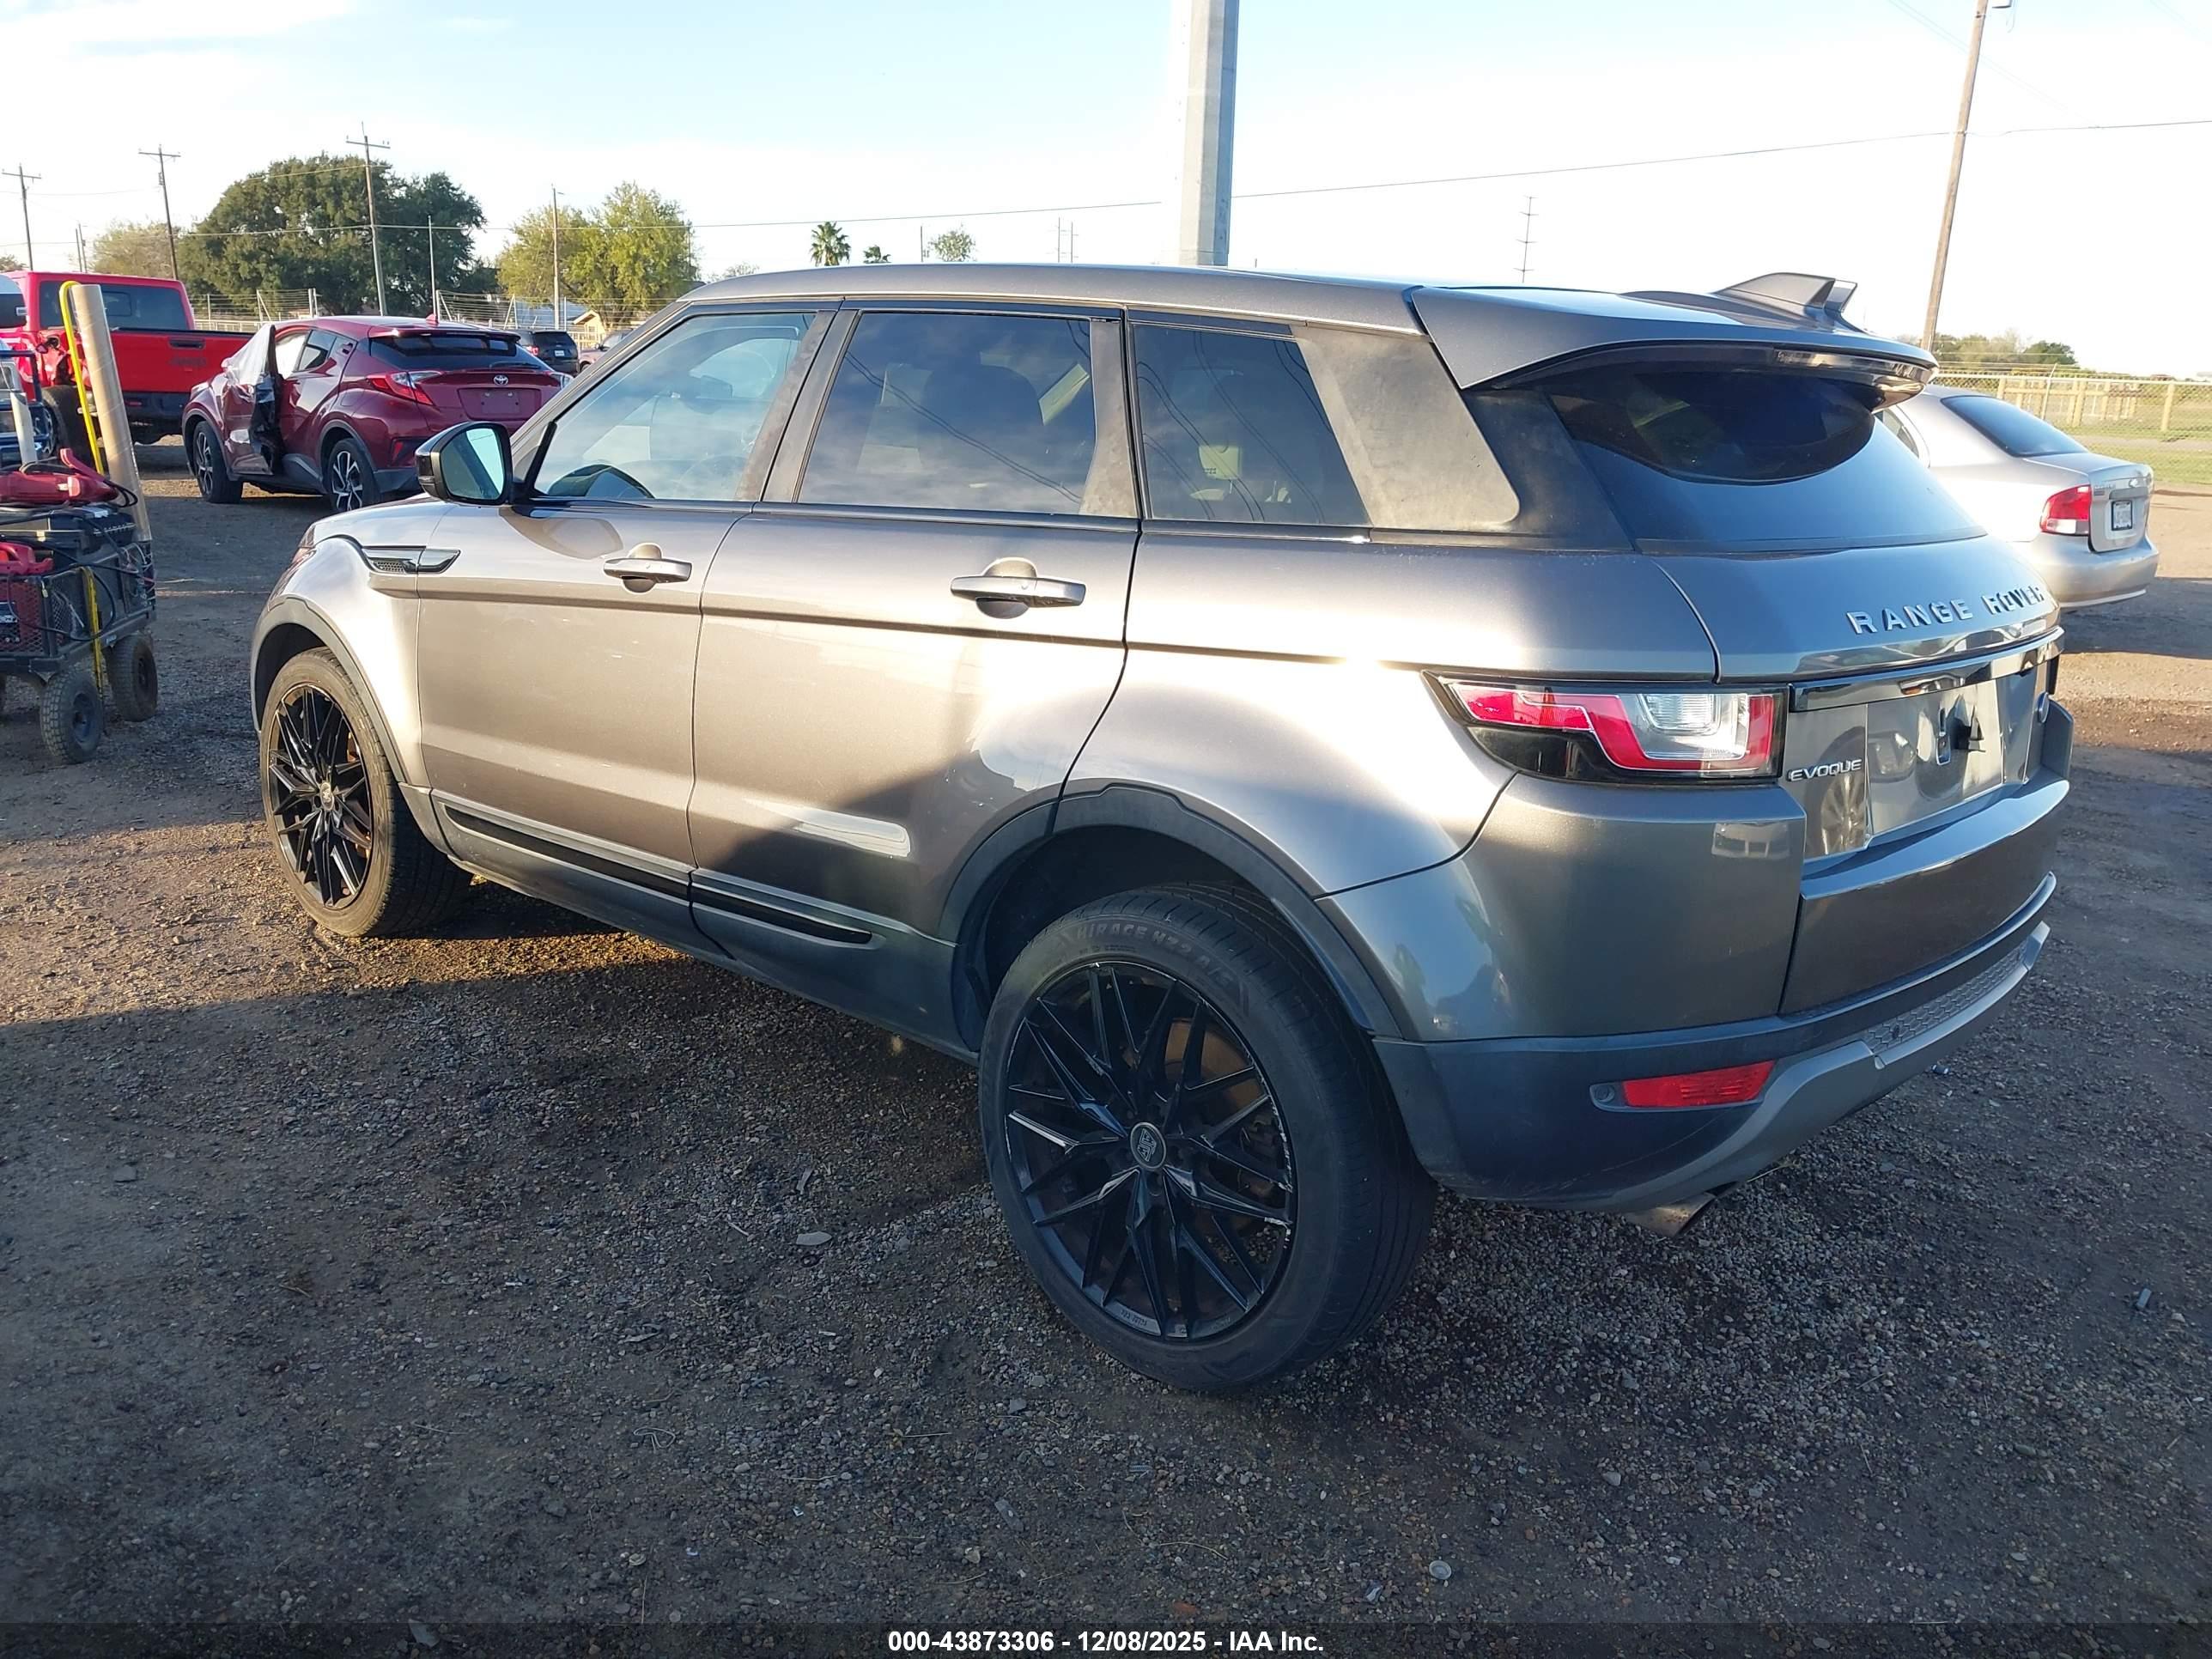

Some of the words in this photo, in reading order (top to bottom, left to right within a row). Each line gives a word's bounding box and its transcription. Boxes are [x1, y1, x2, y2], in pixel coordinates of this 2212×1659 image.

[1845, 599, 1973, 635] RANGE
[1980, 585, 2045, 616] ROVER
[1786, 758, 1863, 781] EVOQUE
